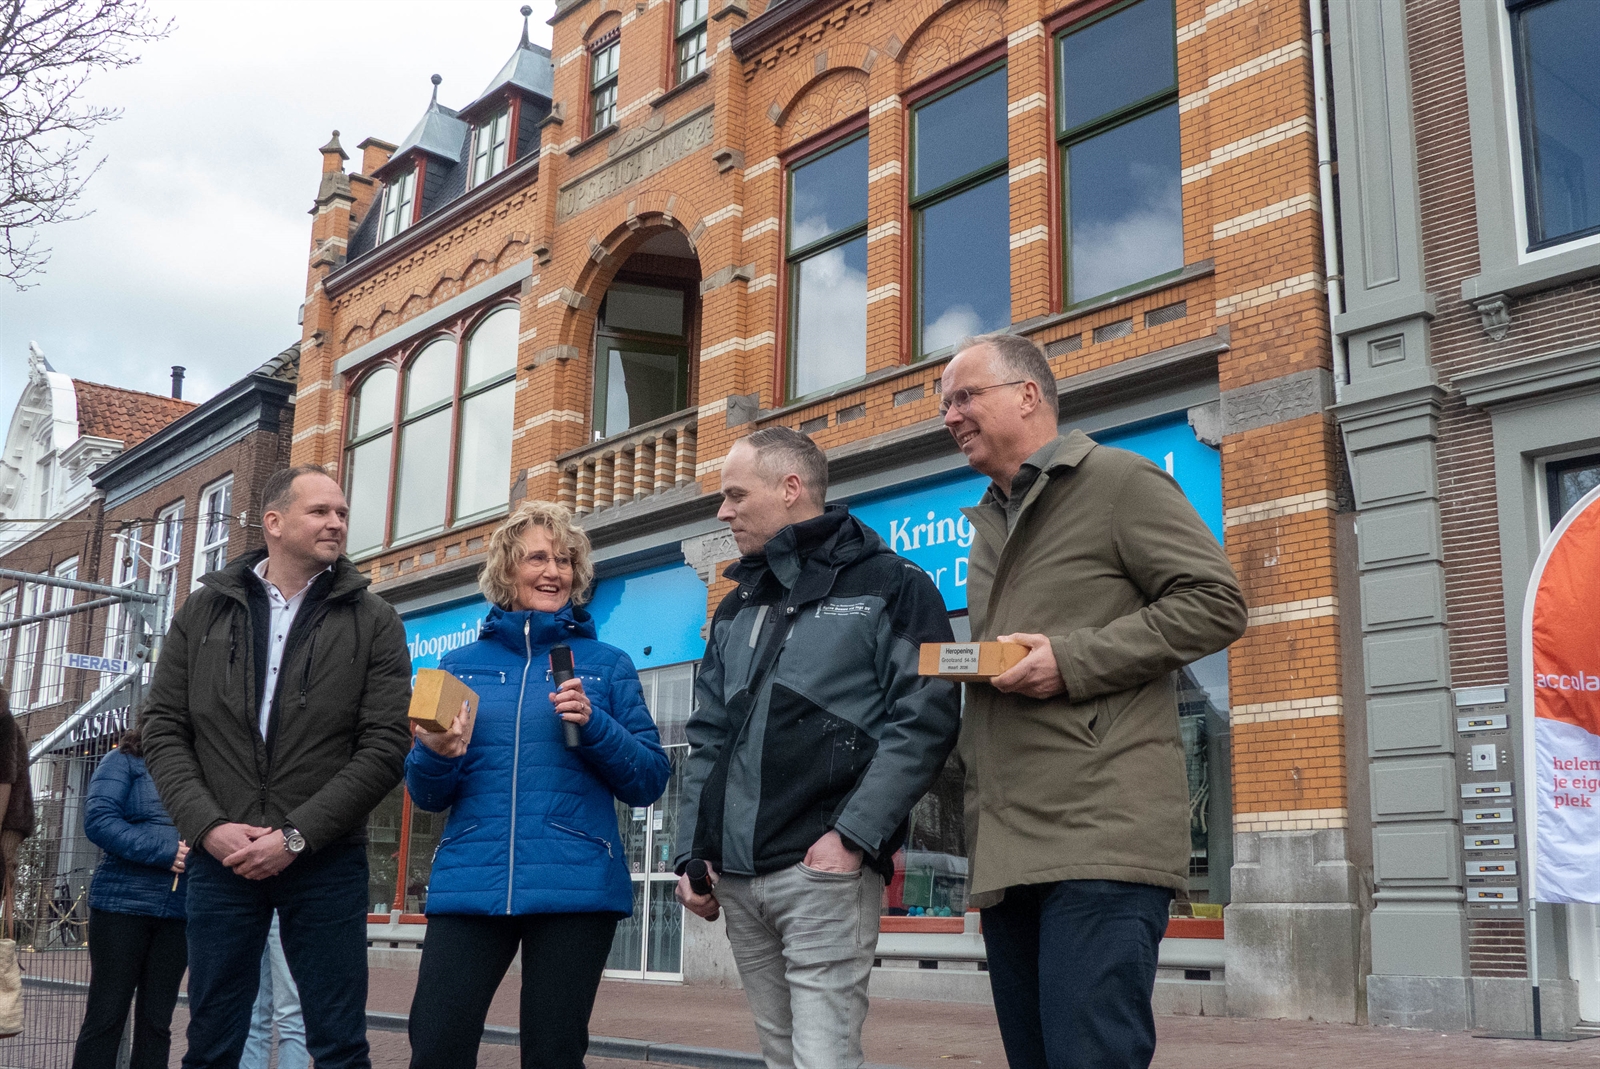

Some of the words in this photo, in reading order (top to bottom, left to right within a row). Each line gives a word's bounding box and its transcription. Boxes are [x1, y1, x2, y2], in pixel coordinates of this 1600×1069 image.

[889, 510, 977, 553] Kring
[945, 647, 974, 656] Heropening
[1553, 775, 1567, 792] je
[1572, 775, 1600, 793] eig
[1554, 793, 1592, 809] plek
